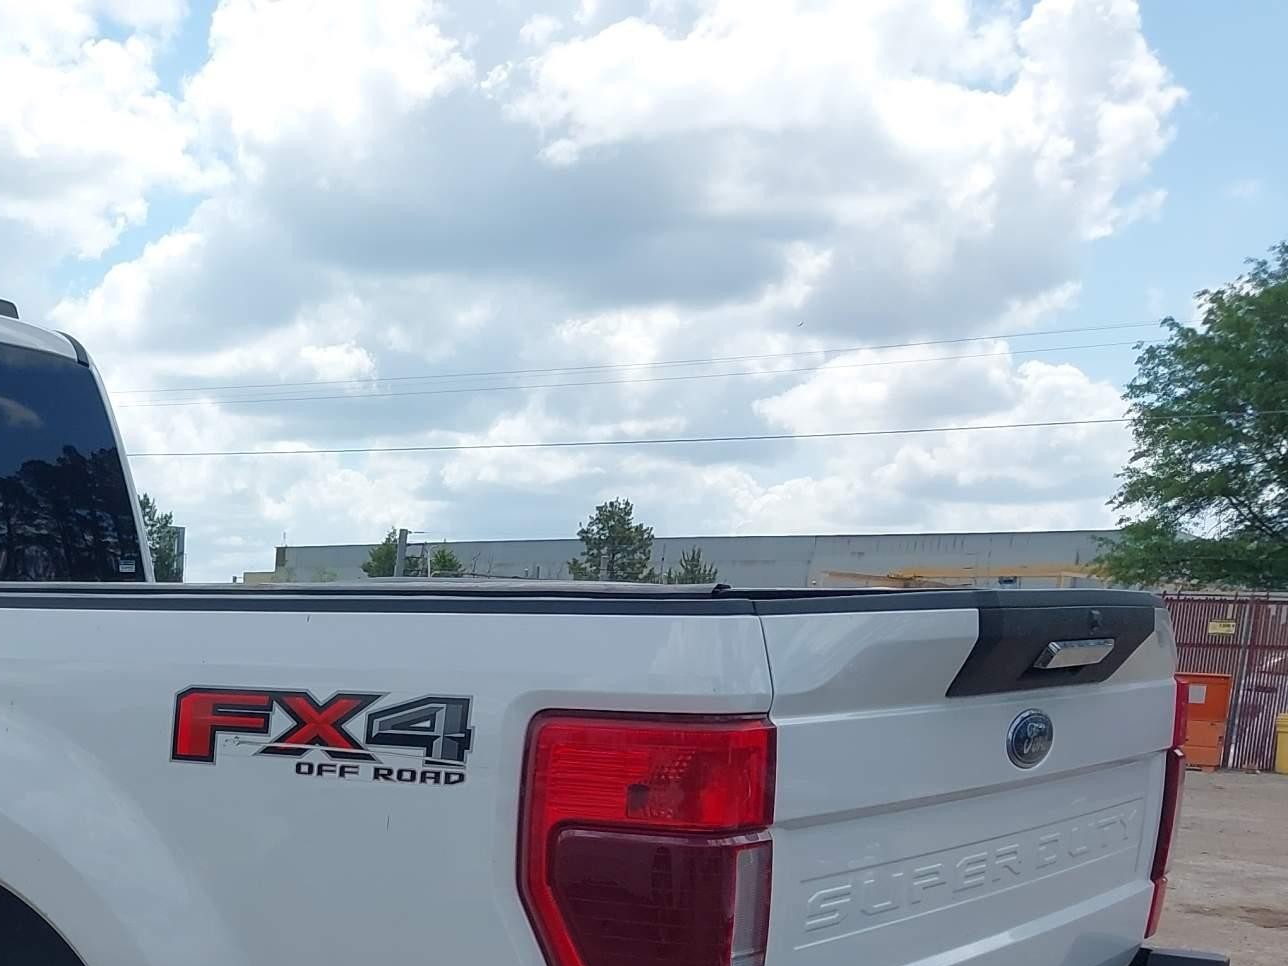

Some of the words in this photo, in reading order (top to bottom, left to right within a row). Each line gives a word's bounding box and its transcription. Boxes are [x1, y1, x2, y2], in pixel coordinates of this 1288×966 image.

[170, 685, 473, 768] FX4
[295, 761, 360, 779] OFF
[372, 766, 466, 786] ROAD
[805, 844, 1024, 933] SUPER
[1034, 808, 1138, 871] DUTY
